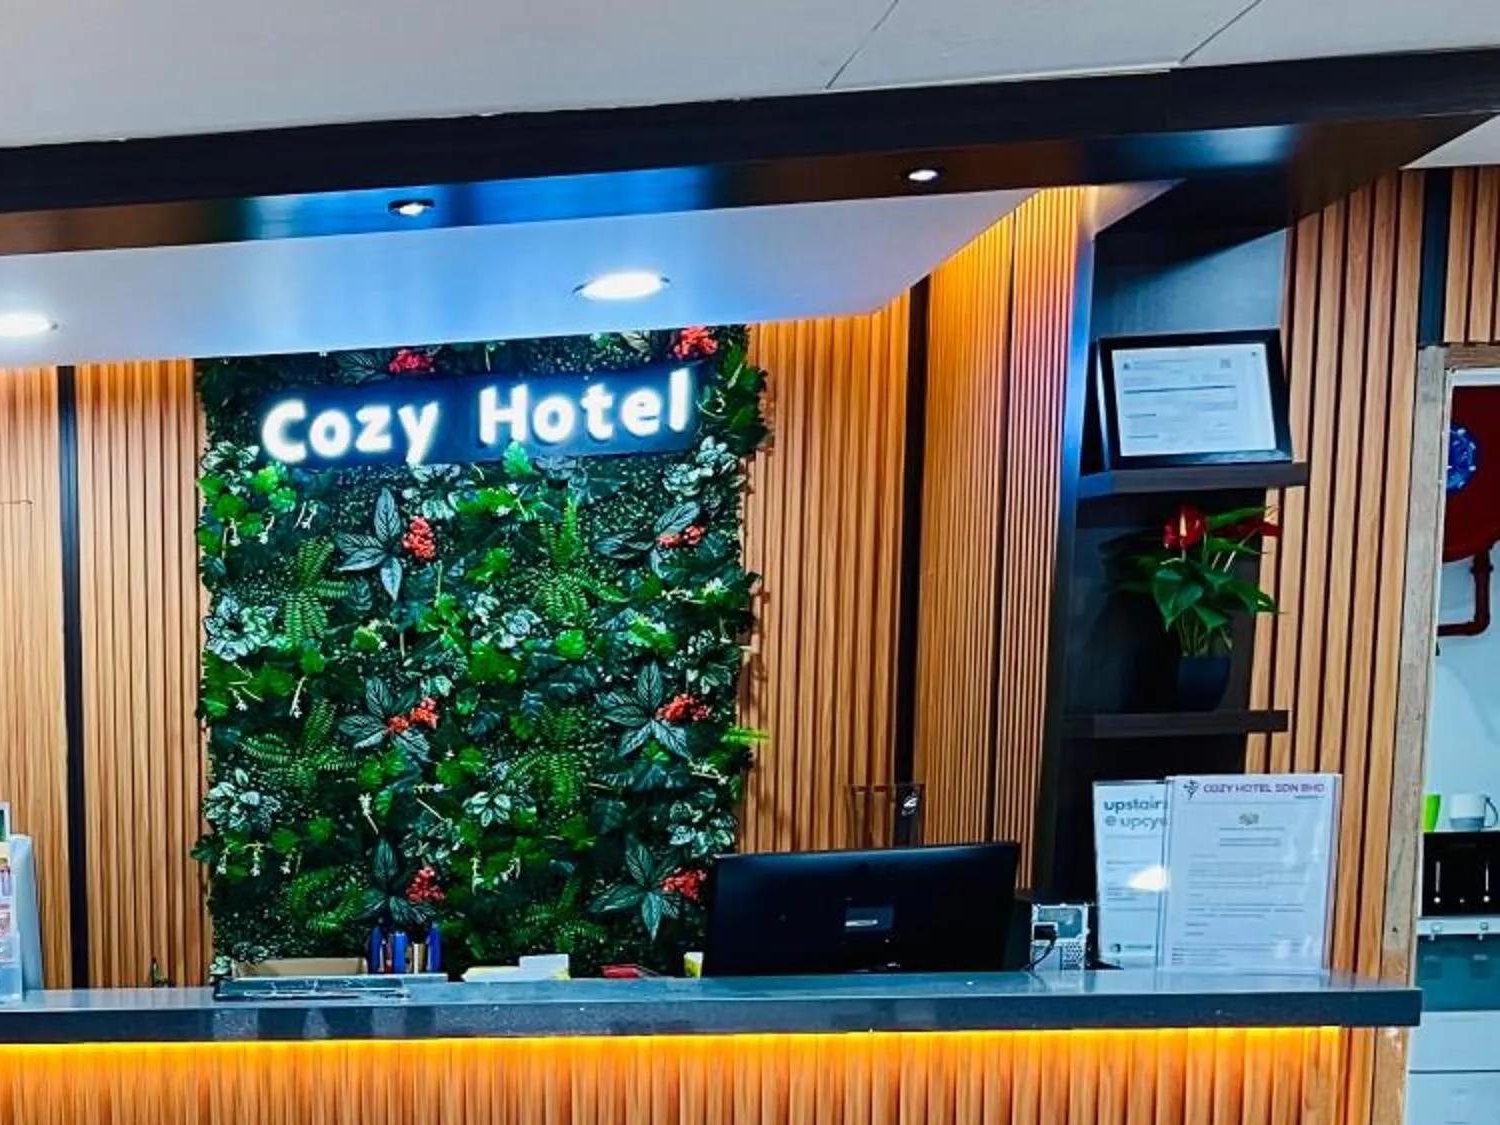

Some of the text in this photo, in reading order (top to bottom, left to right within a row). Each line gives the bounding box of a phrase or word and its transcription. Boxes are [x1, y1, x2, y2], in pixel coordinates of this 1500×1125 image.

[261, 367, 691, 464] Cozy Hotel
[1203, 783, 1325, 793] COZY HOTEL SDN BHD
